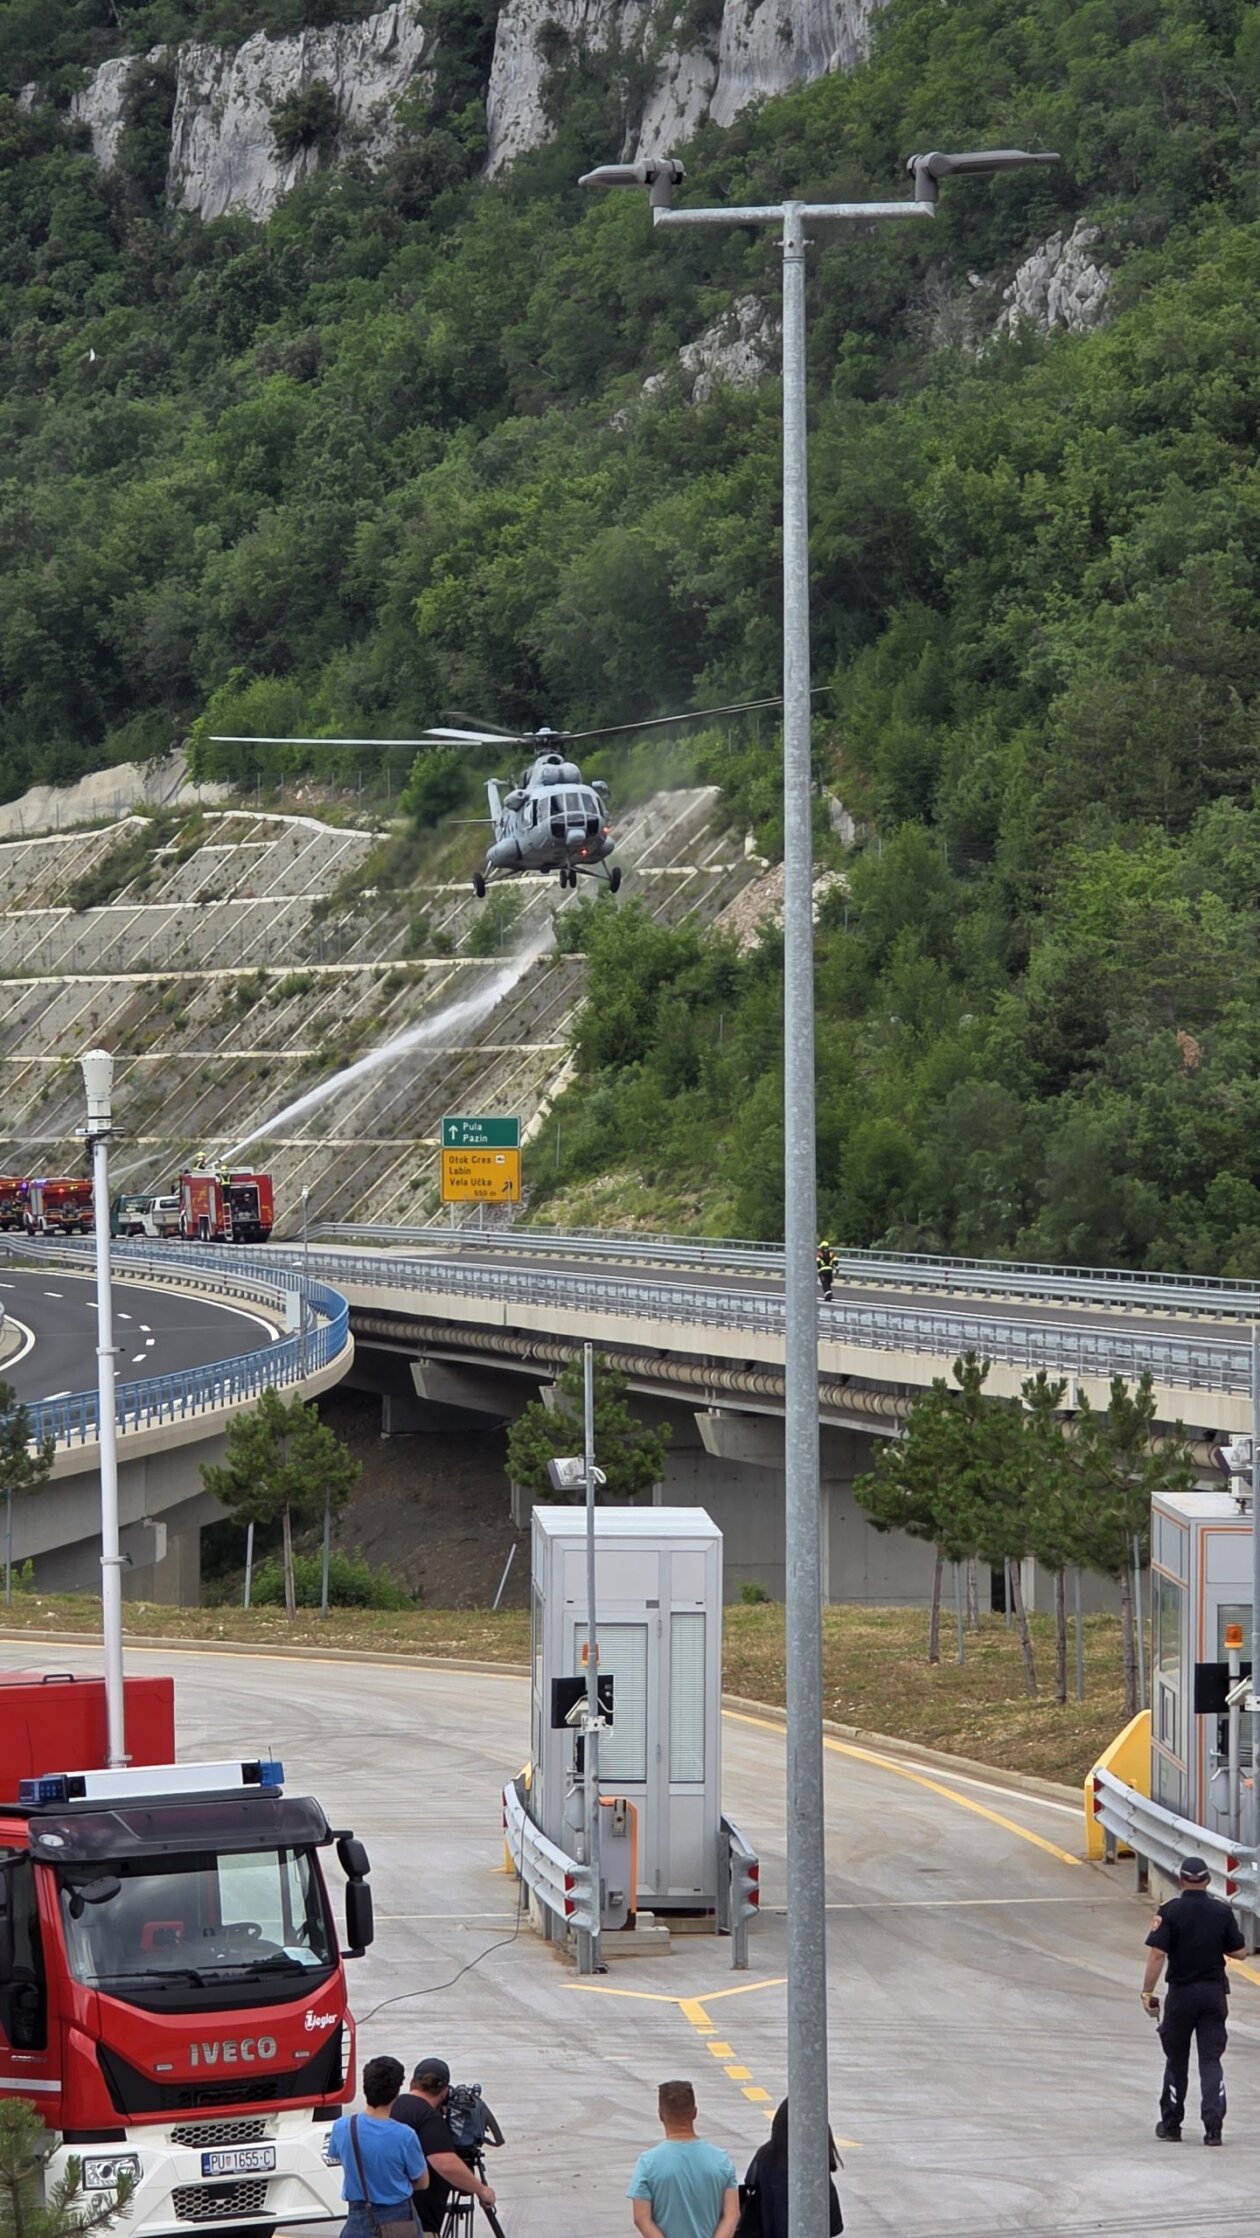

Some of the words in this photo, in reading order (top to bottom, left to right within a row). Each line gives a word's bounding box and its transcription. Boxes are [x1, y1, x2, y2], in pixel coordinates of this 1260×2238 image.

[463, 1122, 482, 1131] Pula
[463, 1134, 488, 1143] Pazin
[449, 1155, 468, 1164] Otok
[471, 1155, 491, 1164] Cres
[449, 1167, 471, 1175] Labin
[449, 1178, 468, 1186] Vela
[305, 2010, 337, 2031] Ziegler
[190, 2036, 277, 2066] IVECO
[211, 2155, 225, 2170] PU
